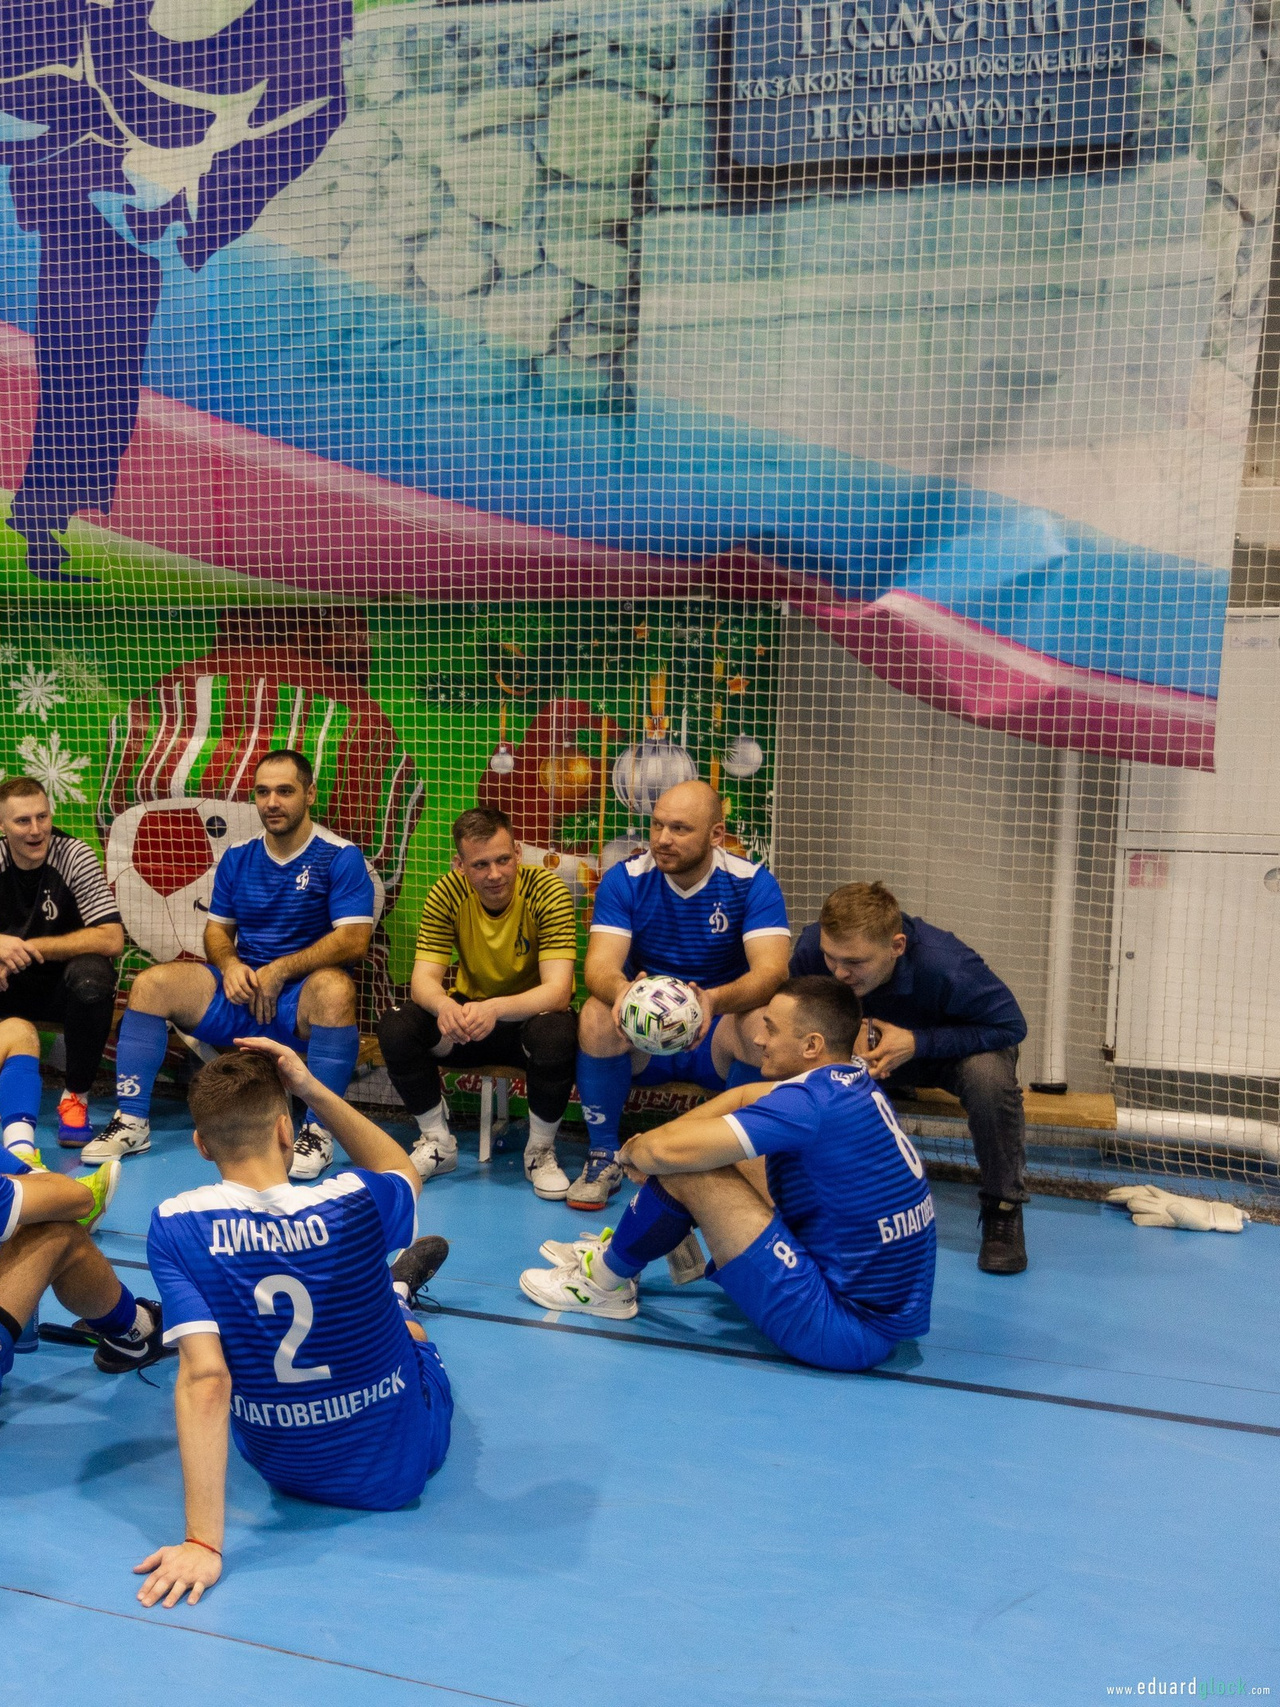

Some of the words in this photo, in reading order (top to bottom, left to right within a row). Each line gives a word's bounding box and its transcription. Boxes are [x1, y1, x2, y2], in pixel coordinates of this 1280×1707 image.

[870, 1091, 923, 1179] 8
[209, 1214, 330, 1257] ДИНАМО
[773, 1240, 797, 1269] 8
[253, 1274, 332, 1384] 2
[231, 1365, 406, 1428] ЛАГОВЕЩЕНСК
